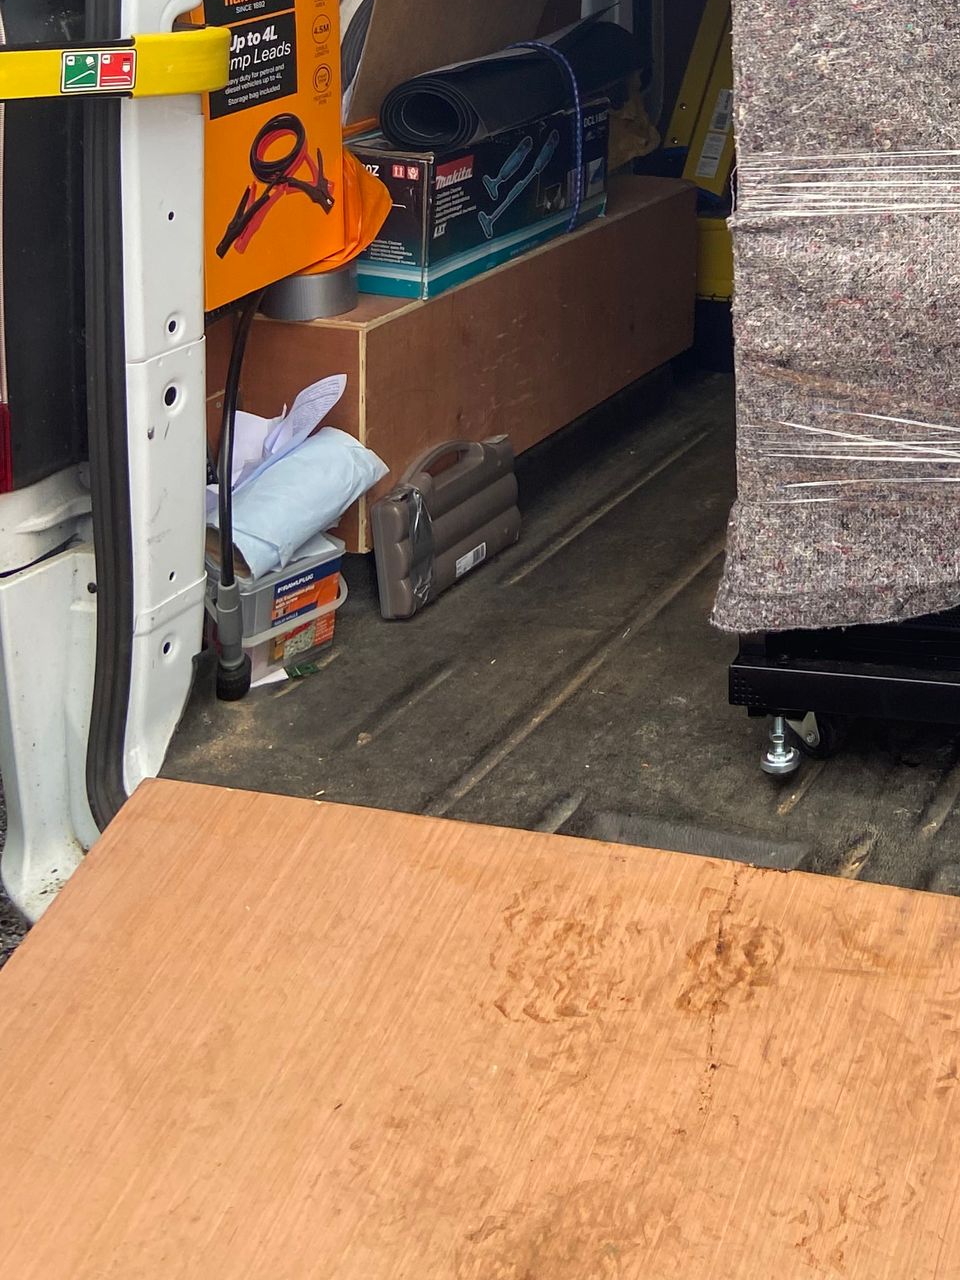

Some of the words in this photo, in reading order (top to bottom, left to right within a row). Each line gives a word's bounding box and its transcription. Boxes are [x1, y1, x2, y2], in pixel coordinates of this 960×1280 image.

[236, 3, 252, 14] SINCE
[246, 32, 260, 46] to
[262, 25, 278, 42] 4L
[230, 54, 251, 71] mp
[254, 40, 292, 64] Leads
